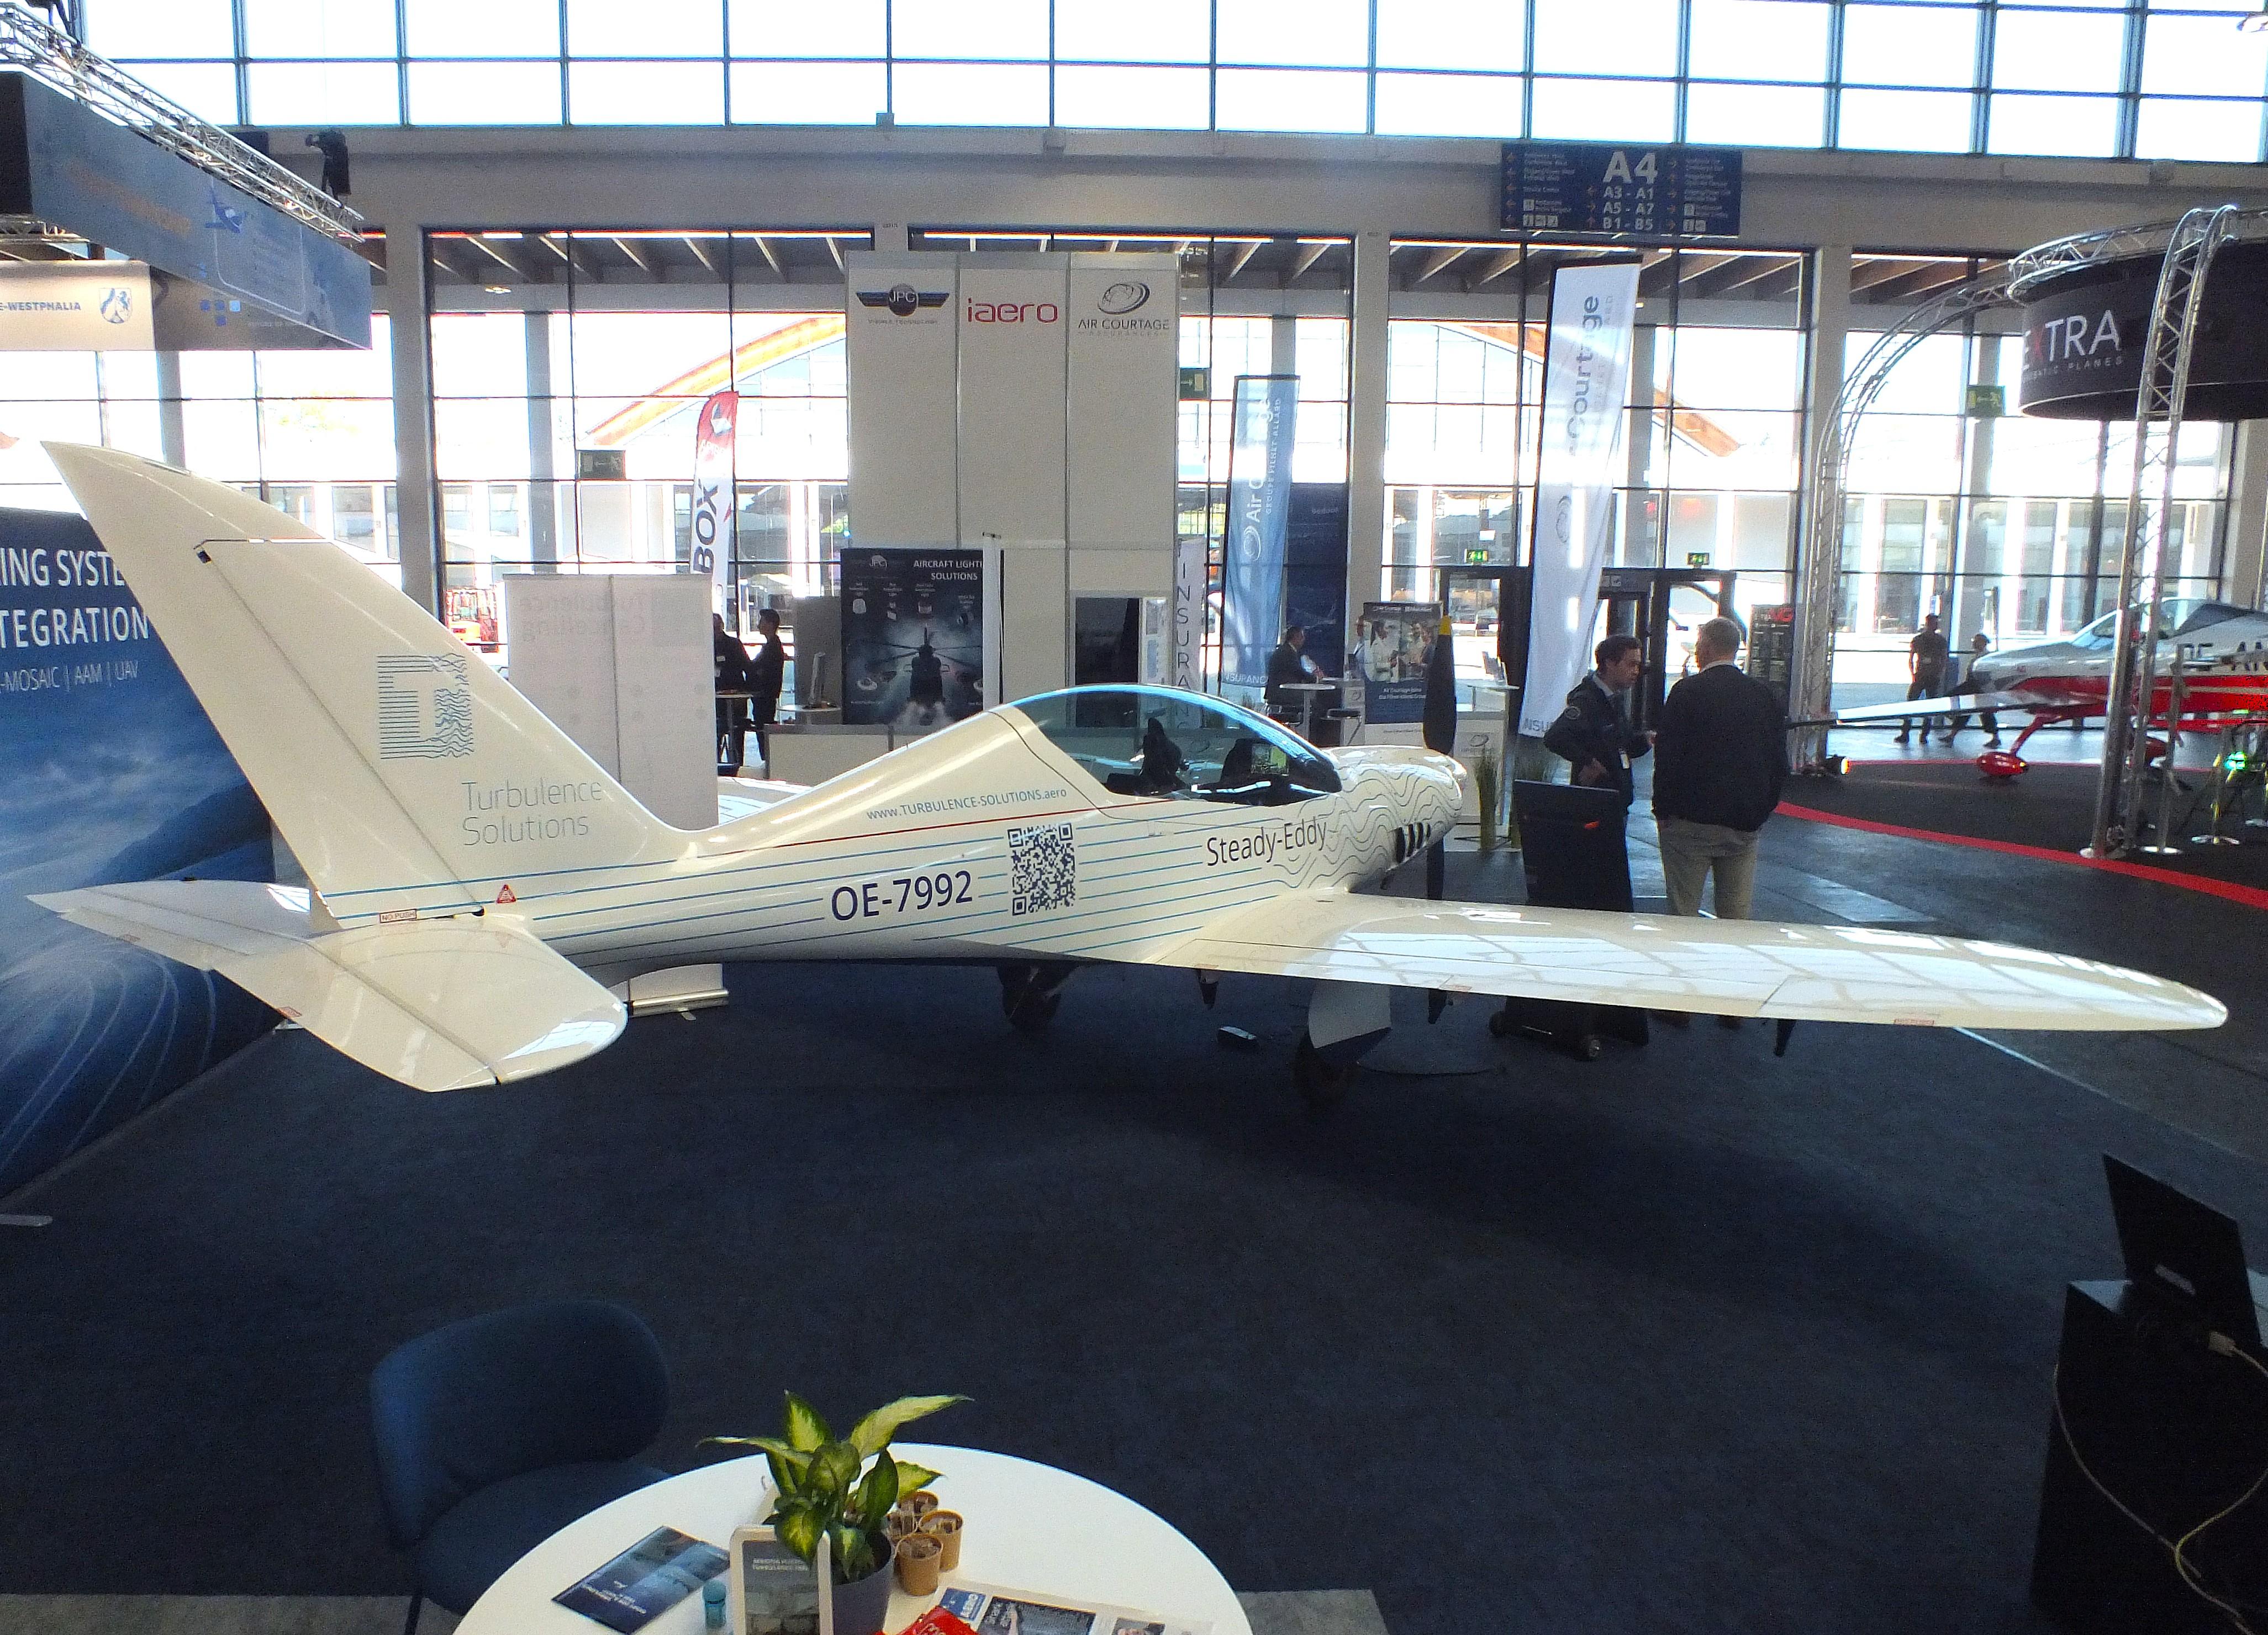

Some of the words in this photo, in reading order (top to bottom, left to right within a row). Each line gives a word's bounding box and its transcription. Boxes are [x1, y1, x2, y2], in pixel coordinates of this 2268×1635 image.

[1602, 151, 1658, 184] A4
[1604, 201, 1622, 214] A5
[1636, 202, 1654, 215] A7
[1635, 187, 1654, 200] A1
[968, 297, 1058, 323] iaero
[1078, 319, 1098, 329] AIR
[1101, 319, 1170, 330] COURTAGE
[1567, 296, 1603, 439] Courtge
[1246, 494, 1262, 523] Air
[0, 547, 50, 587] ING
[913, 560, 954, 568] AIRCRAFT
[956, 560, 982, 568] LIGHTI
[931, 572, 978, 581] SOLUTIONS
[0, 606, 149, 648] TEGRATION
[461, 778, 603, 811] Turbulence
[866, 788, 1067, 820] www.TURBULENCE-SOLUTIONS.aero
[462, 814, 589, 846] Solutions
[1206, 816, 1327, 867] Steady-Eddy
[831, 870, 973, 921] OE-7992
